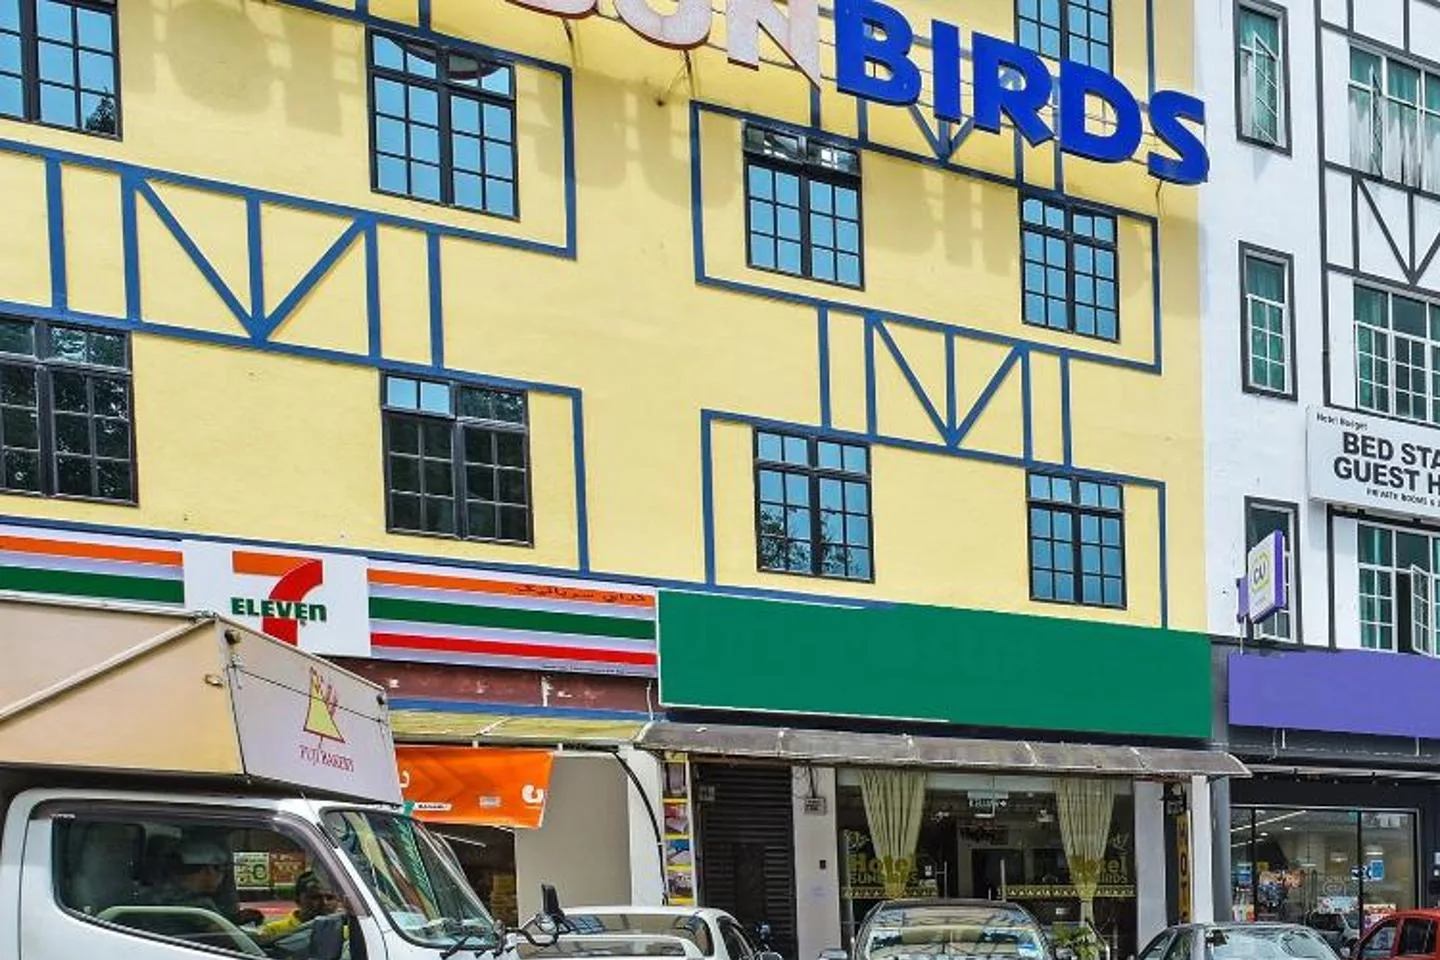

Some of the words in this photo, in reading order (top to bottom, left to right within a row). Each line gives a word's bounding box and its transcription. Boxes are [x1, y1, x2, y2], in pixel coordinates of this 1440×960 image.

[500, 0, 1210, 185] NBIRDS
[1334, 456, 1419, 492] GUEST
[1343, 432, 1394, 461] BED
[232, 551, 323, 646] 7
